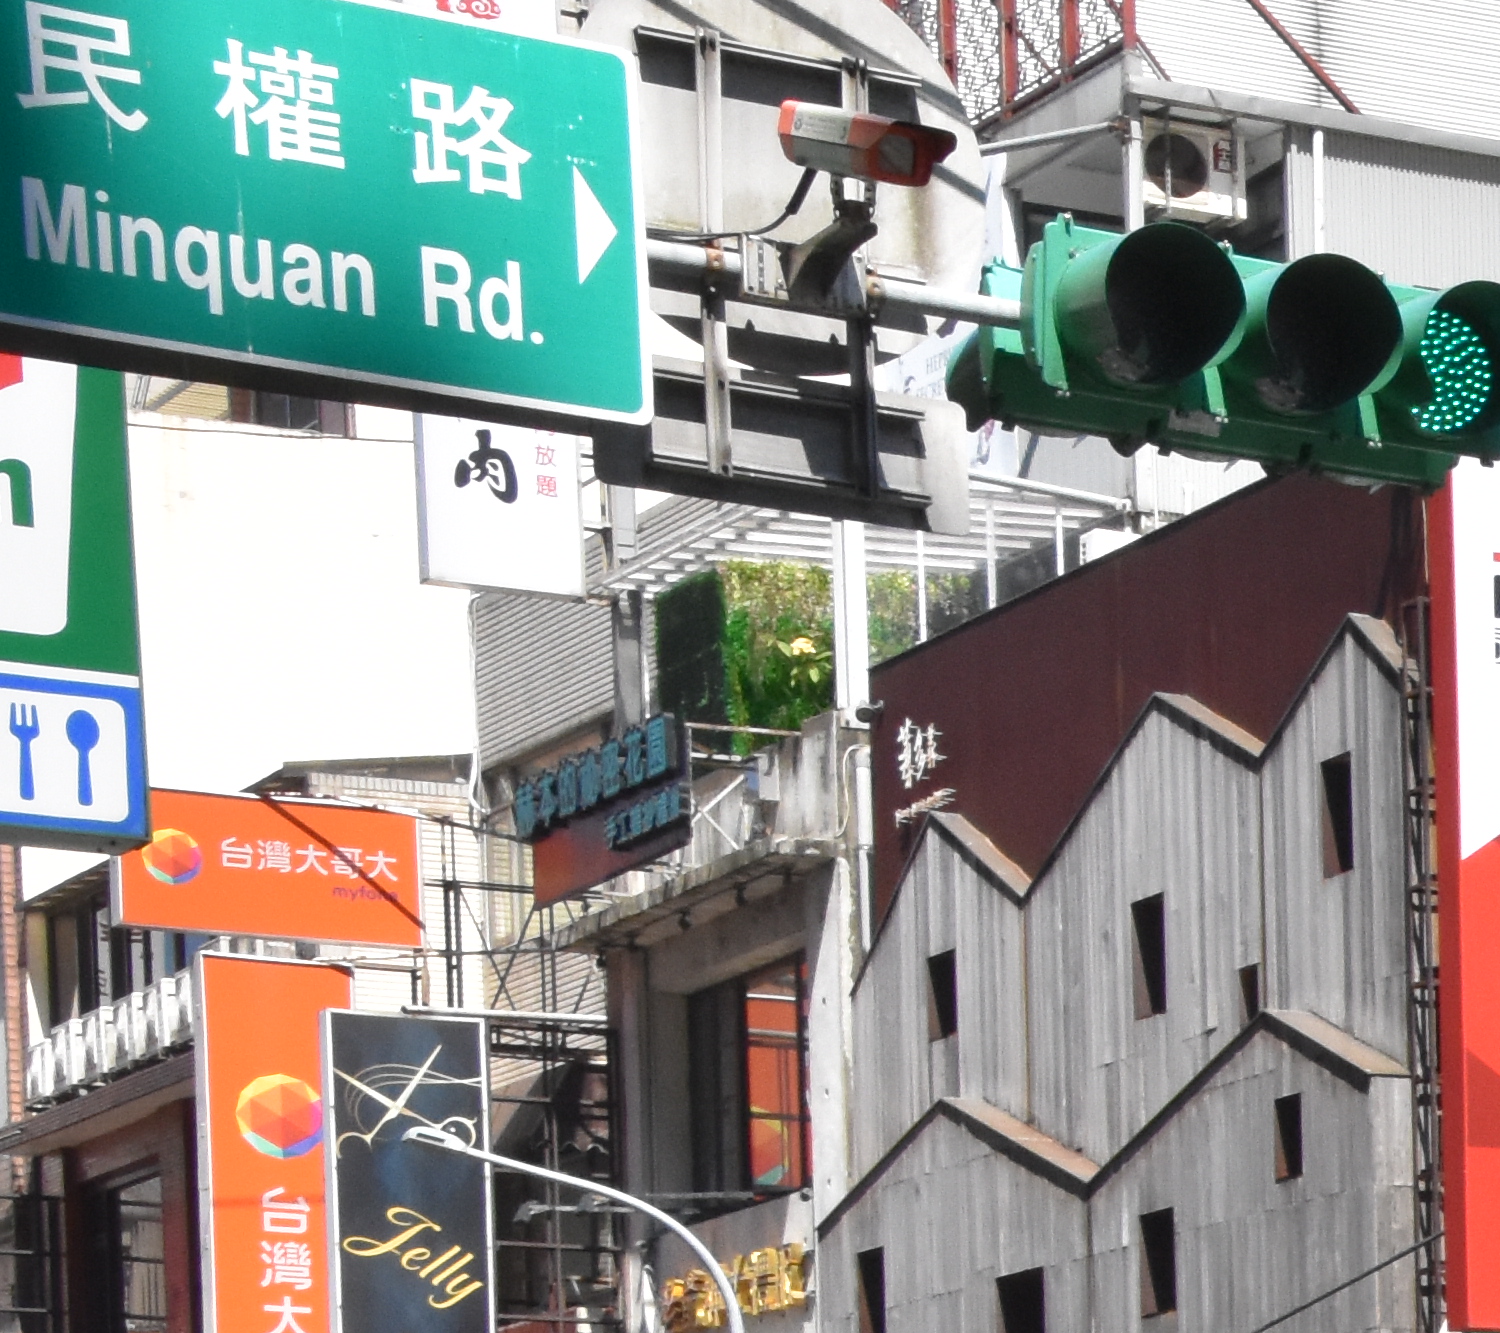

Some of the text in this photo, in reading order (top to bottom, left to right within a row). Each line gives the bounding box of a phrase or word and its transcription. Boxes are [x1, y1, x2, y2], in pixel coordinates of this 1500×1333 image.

[17, 0, 532, 201] 民權路
[23, 176, 544, 345] Minquan Rd.
[535, 426, 558, 497] 放題
[222, 836, 398, 883] 台灣大哥大
[344, 1207, 484, 1307] Jelly
